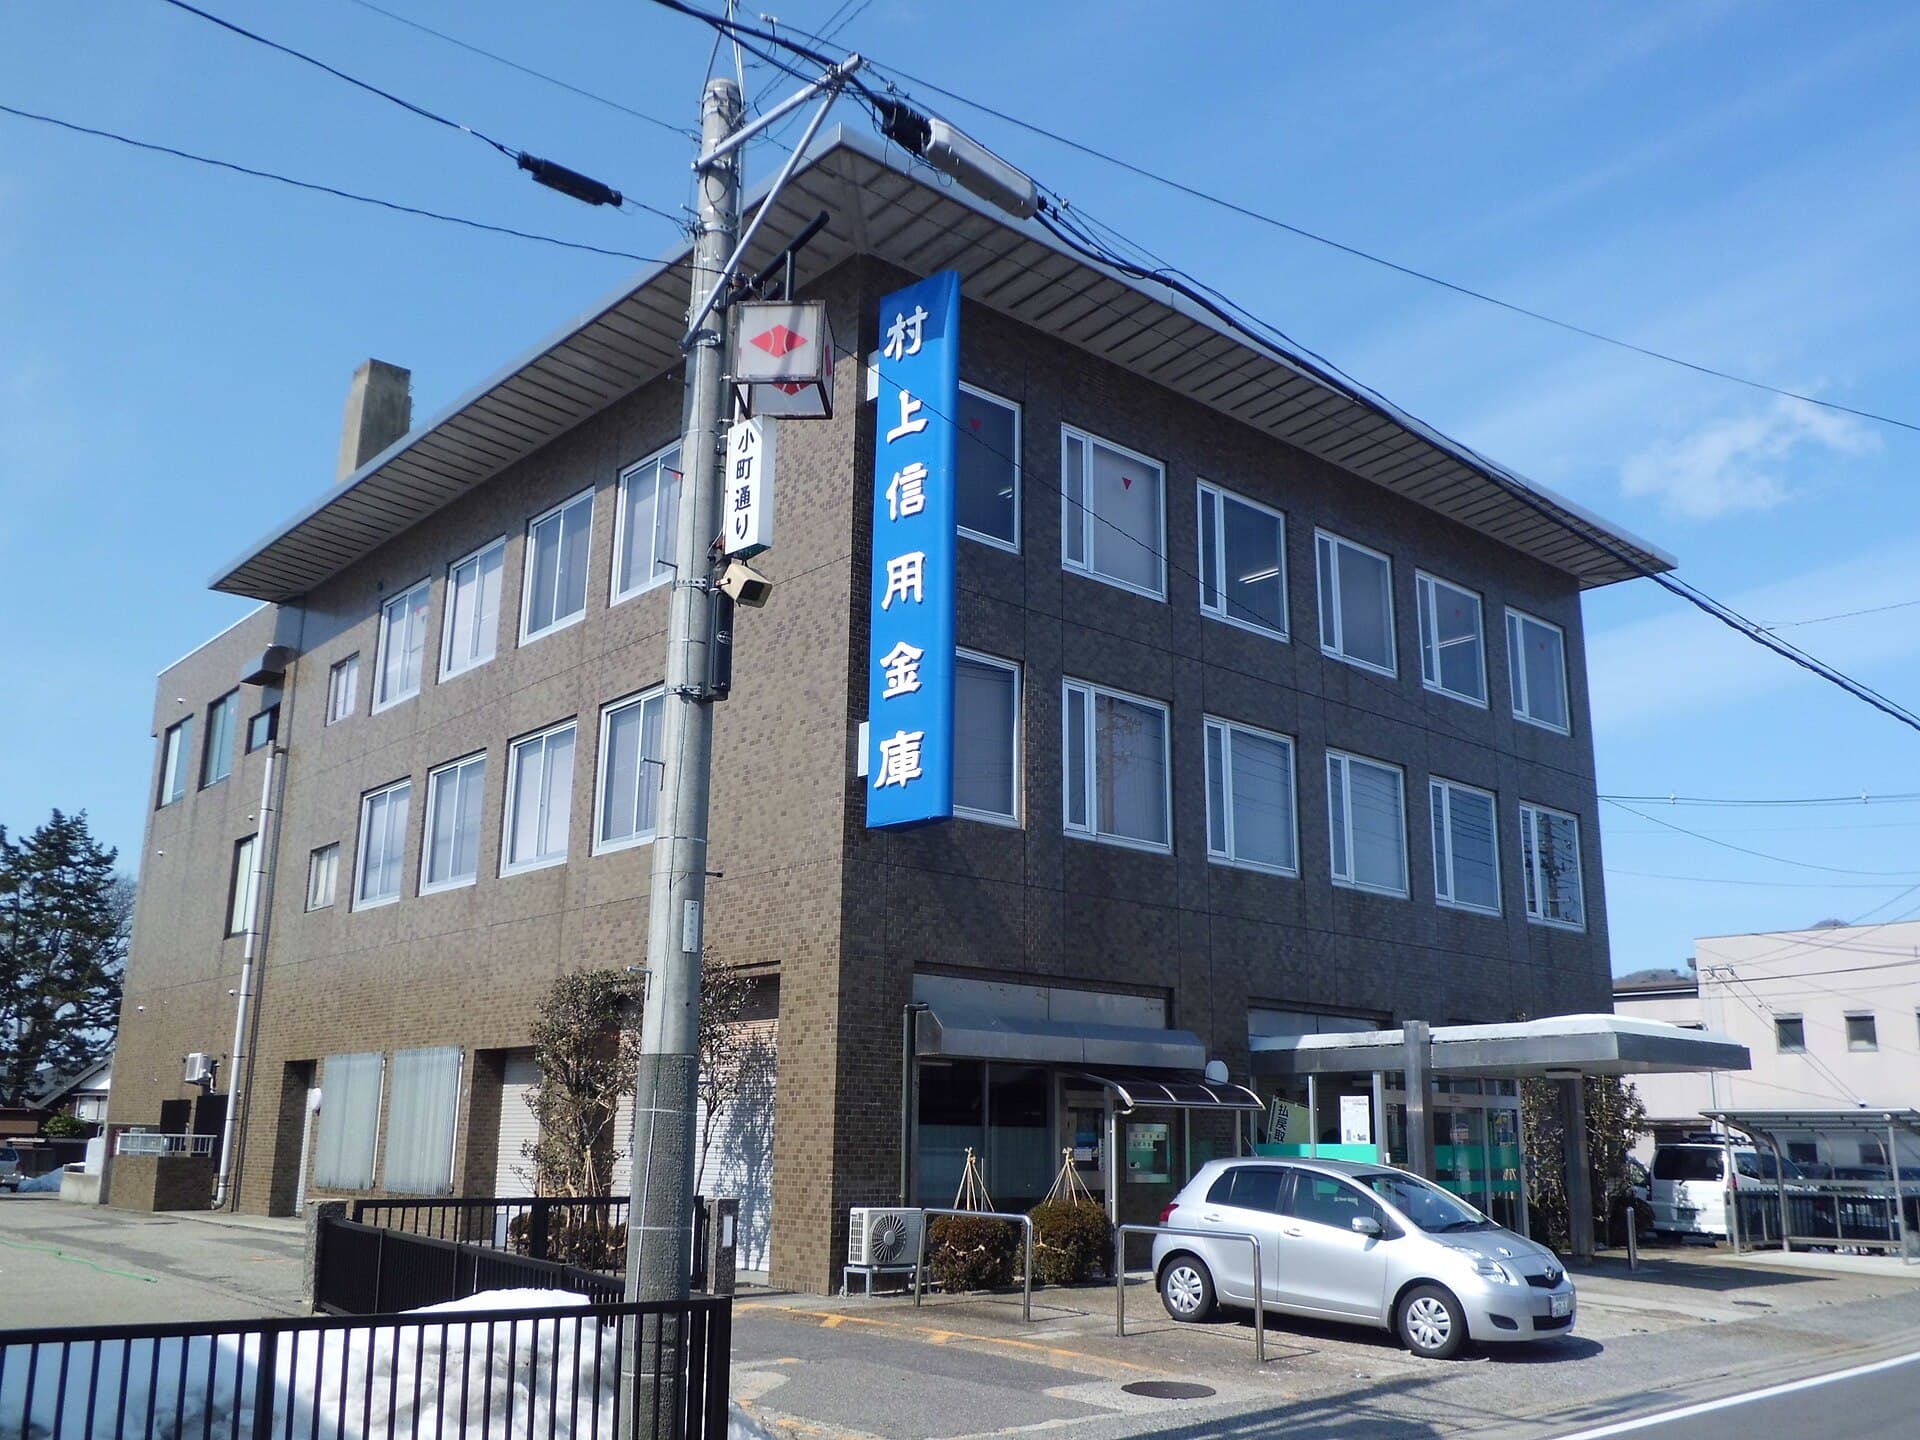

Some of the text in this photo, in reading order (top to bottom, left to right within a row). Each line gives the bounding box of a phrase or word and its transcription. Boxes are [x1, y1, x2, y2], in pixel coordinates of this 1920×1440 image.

[734, 428, 755, 540] 小町通り
[874, 305, 929, 789] 村上信用金庫
[1273, 1103, 1289, 1144] 払戻取
